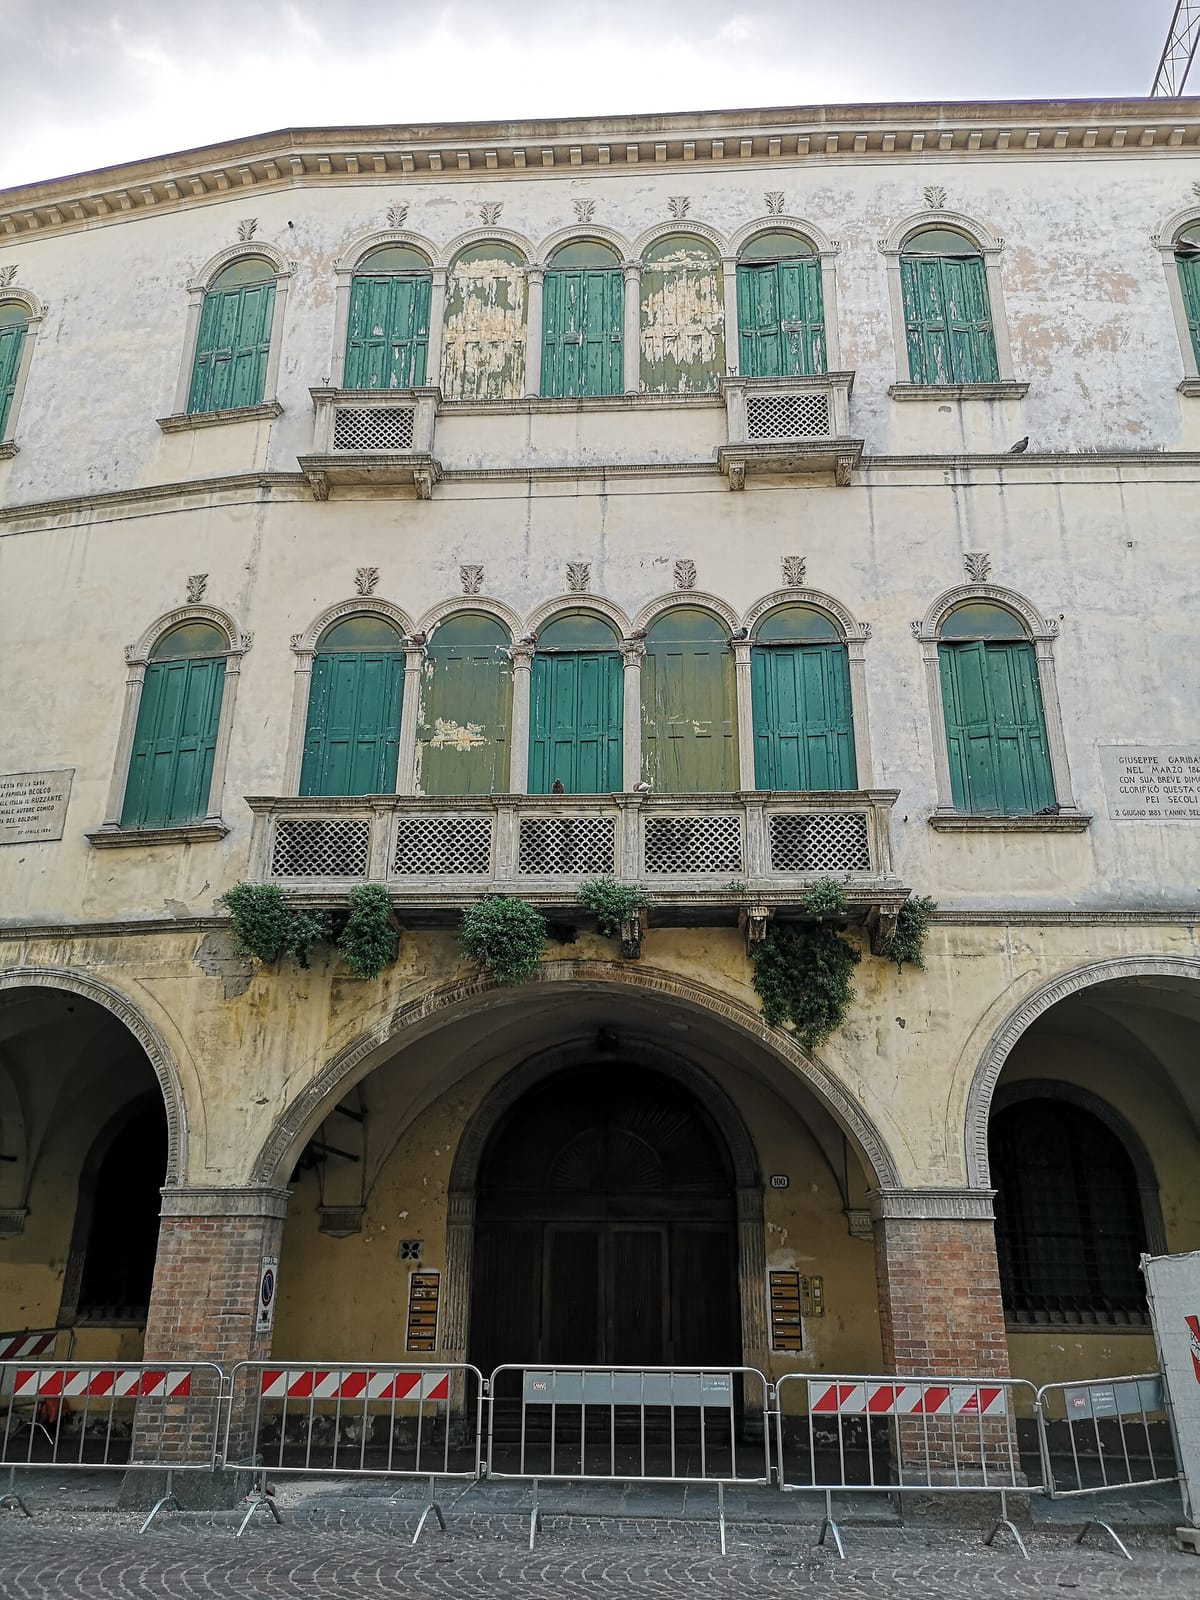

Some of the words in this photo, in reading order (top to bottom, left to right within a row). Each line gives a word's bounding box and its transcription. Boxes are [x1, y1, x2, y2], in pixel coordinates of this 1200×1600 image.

[1118, 756, 1159, 764] GIUSEPPE
[1126, 766, 1144, 774] NEL
[1151, 766, 1183, 774] MARZO
[1188, 766, 1200, 774] 186
[1119, 776, 1136, 784] CON
[1139, 776, 1155, 784] SUA
[1157, 776, 1181, 784] BREVE
[1162, 785, 1195, 794] QUESTA
[1145, 795, 1160, 804] PEI
[1167, 795, 1198, 804] SECOLI
[1121, 809, 1147, 817] GIUGNO
[773, 1177, 786, 1186] 100
